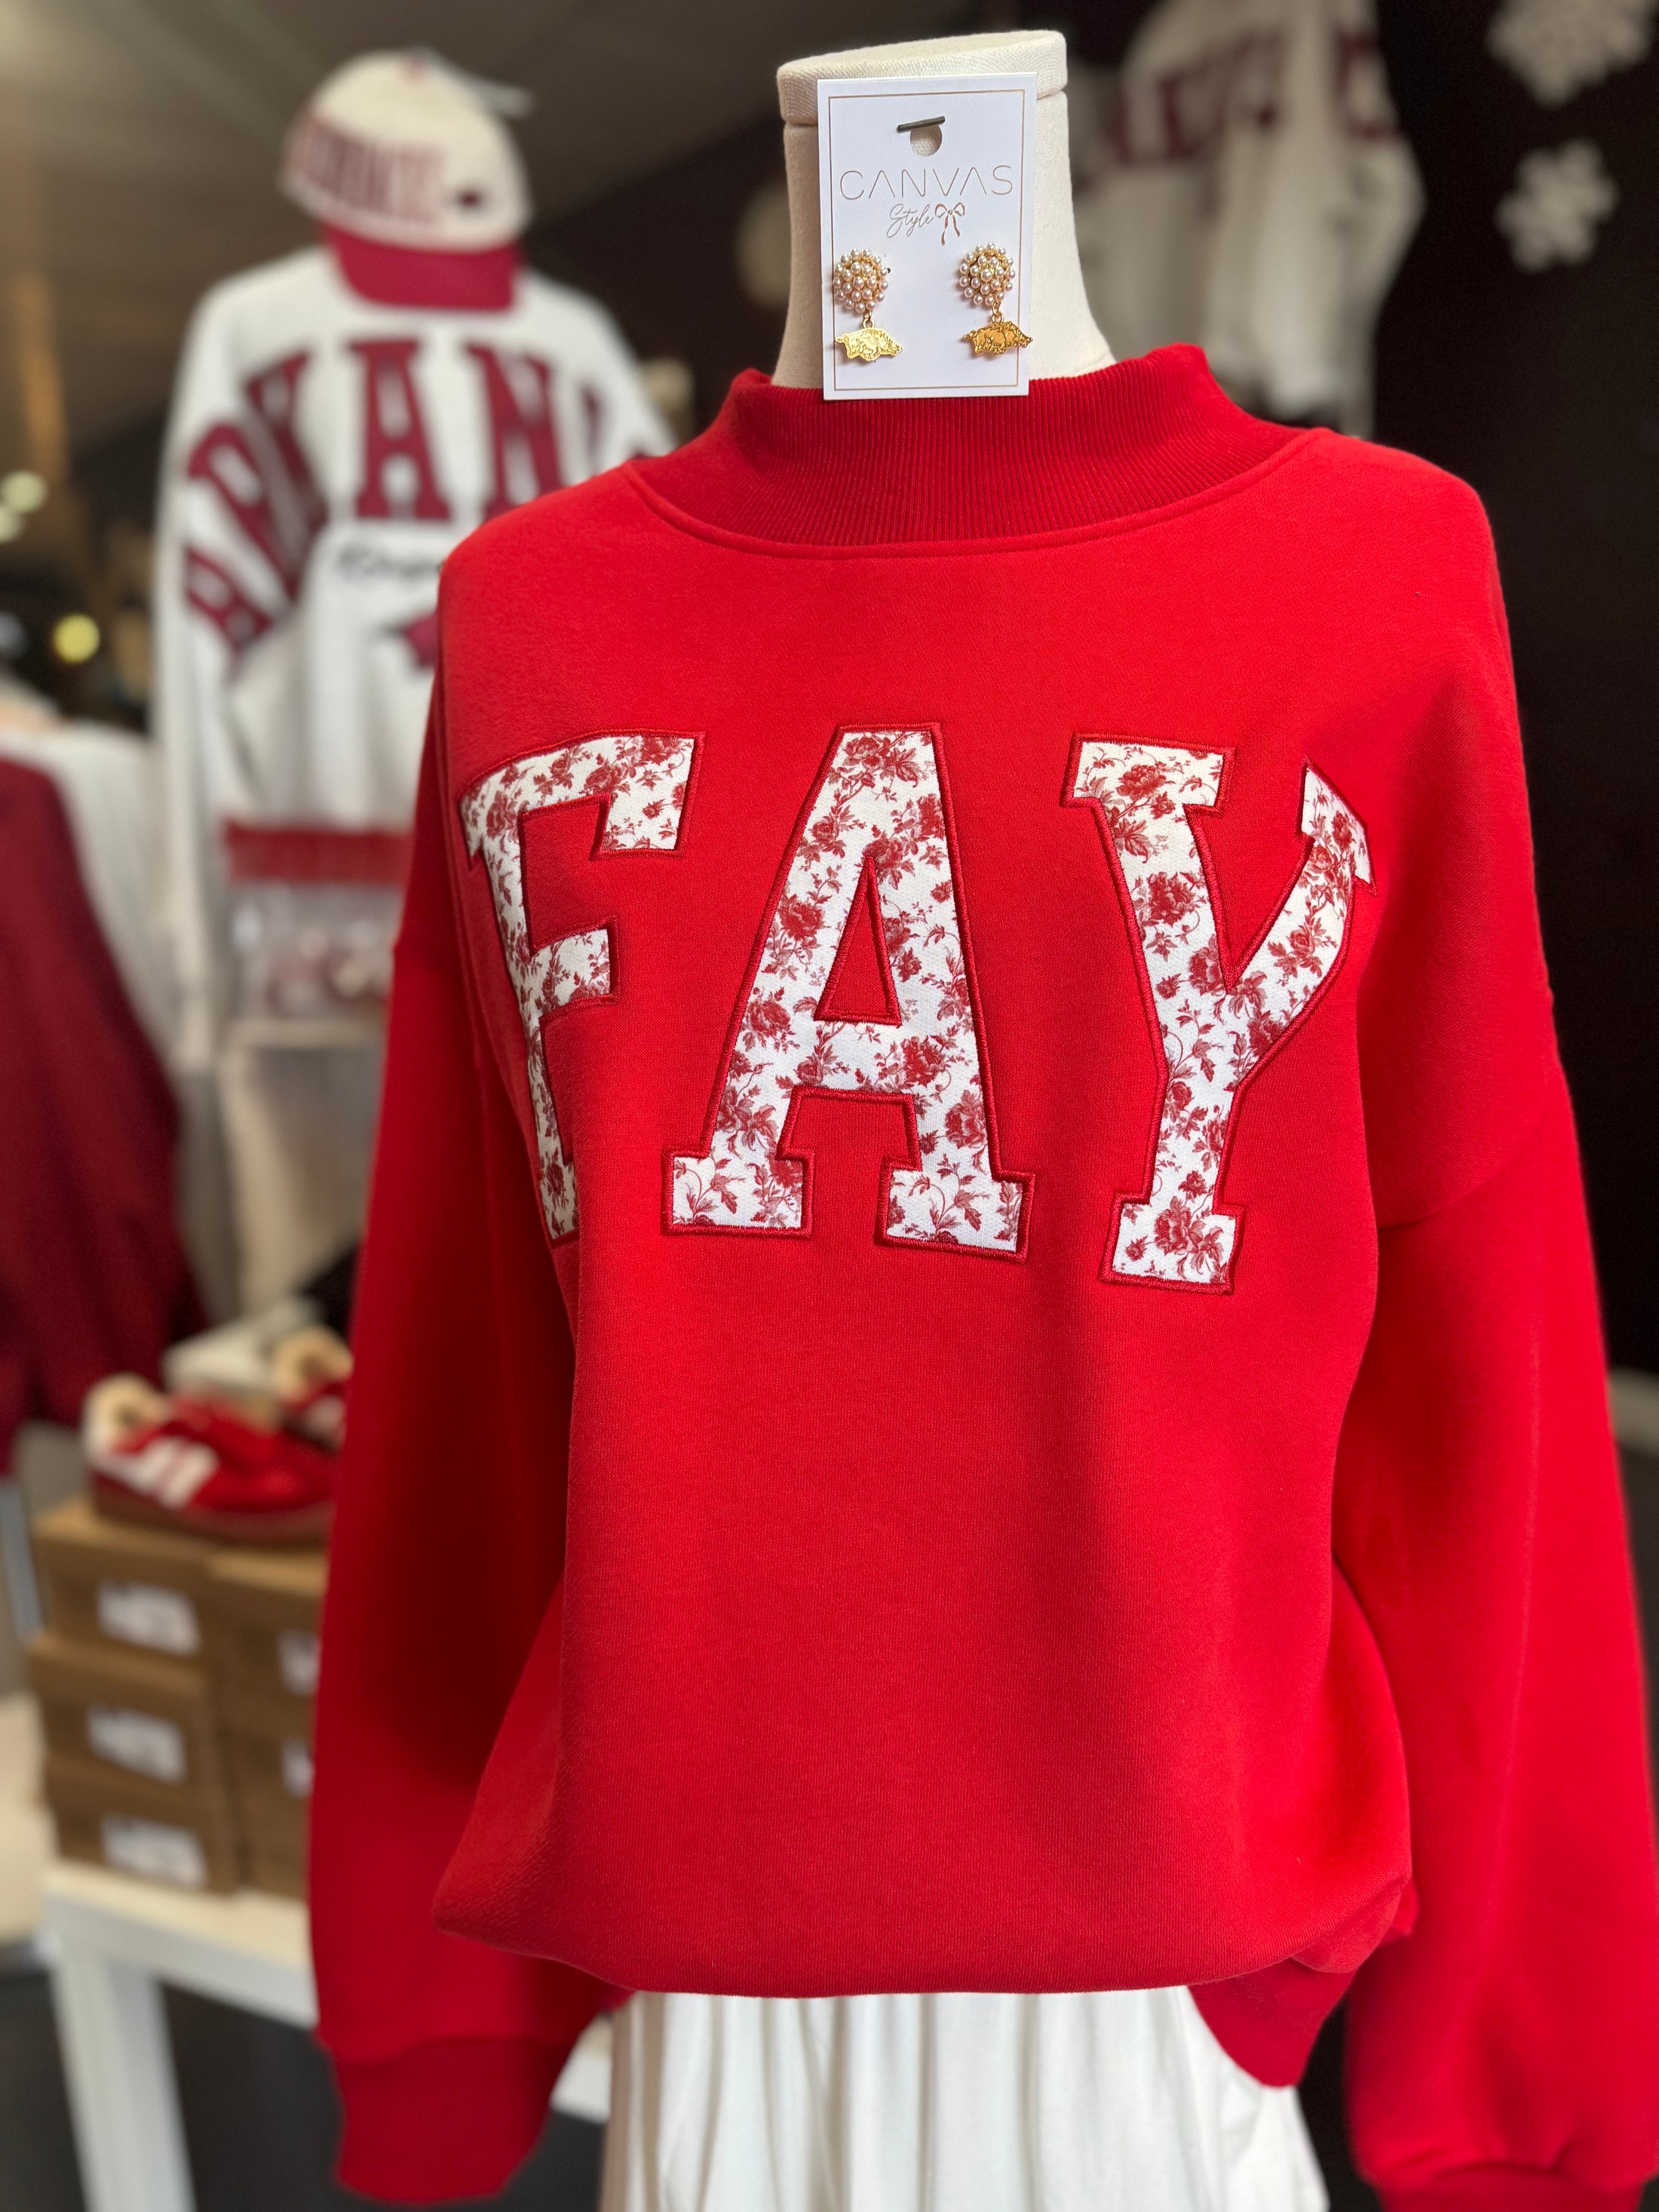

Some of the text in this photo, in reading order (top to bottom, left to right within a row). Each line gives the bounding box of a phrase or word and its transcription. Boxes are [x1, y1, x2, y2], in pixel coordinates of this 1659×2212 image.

[839, 164, 1013, 201] CANVAS
[885, 203, 934, 238] Style
[458, 722, 1375, 1293] FAY
